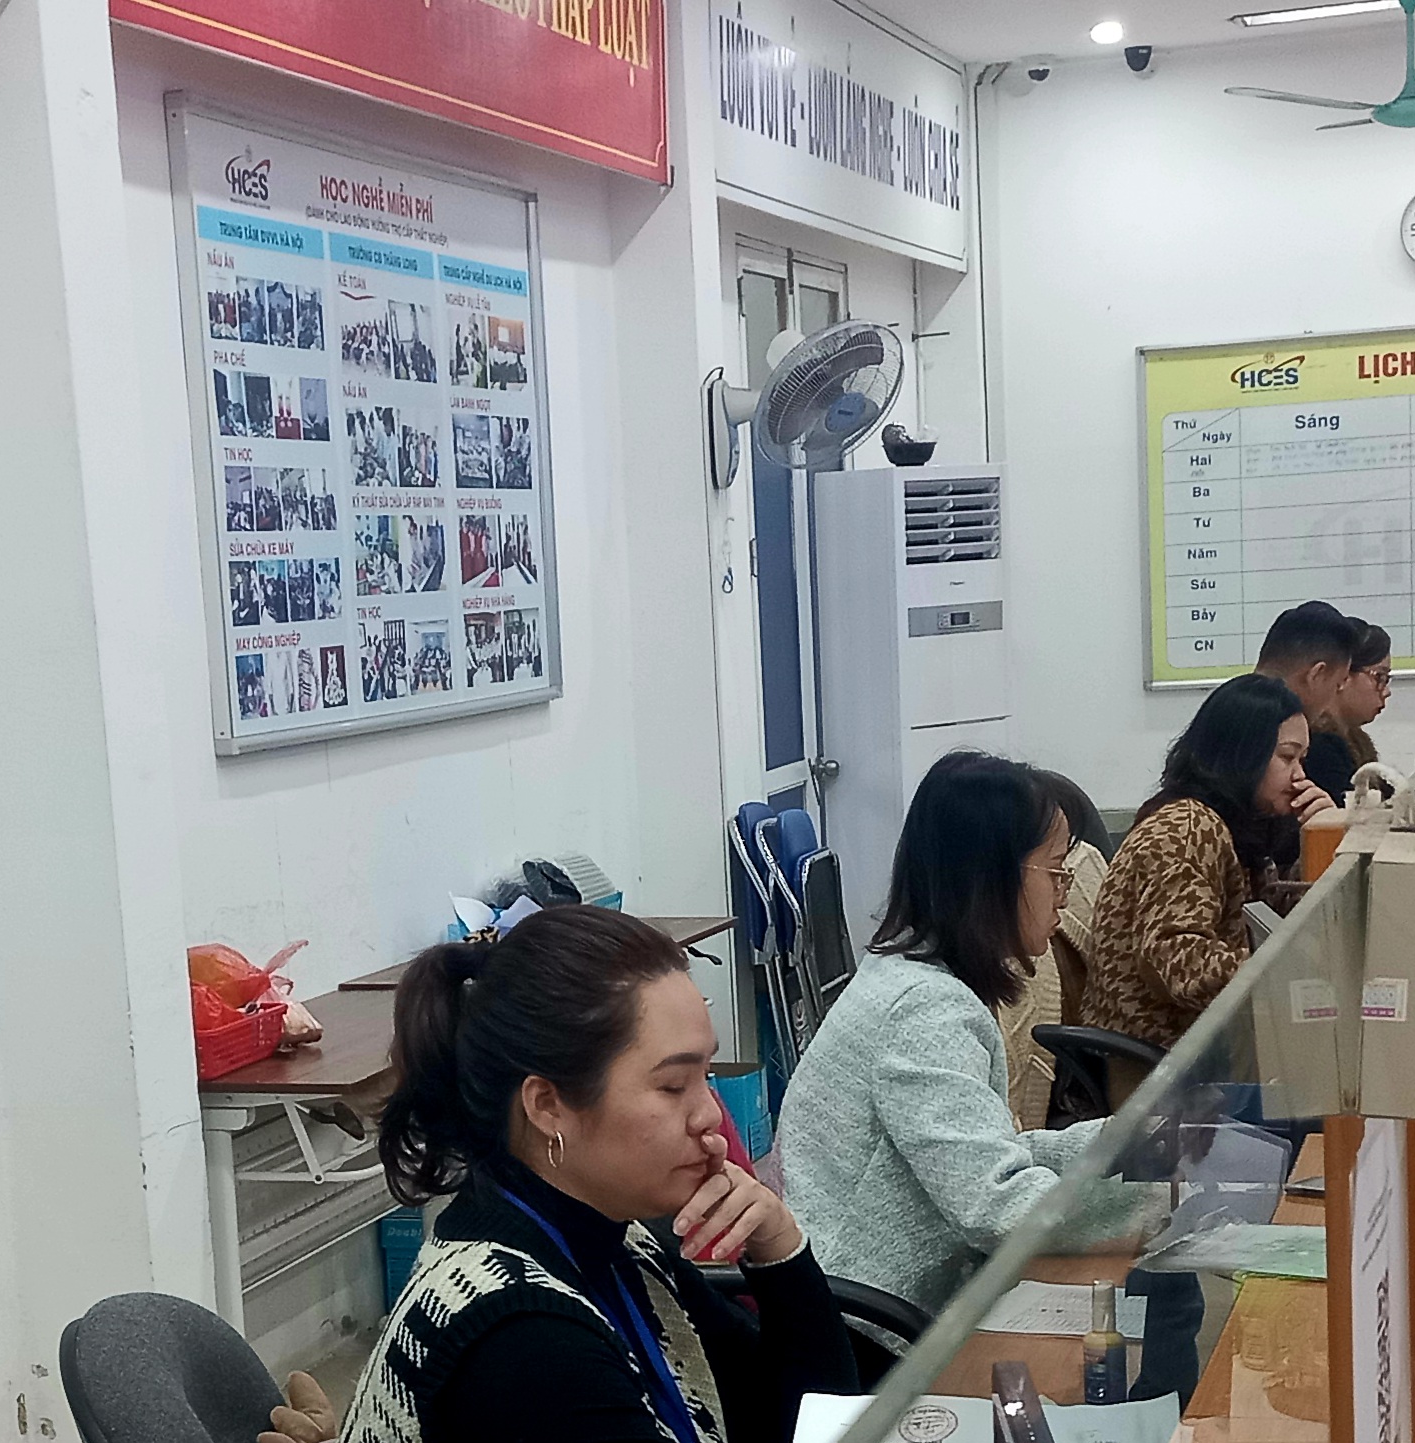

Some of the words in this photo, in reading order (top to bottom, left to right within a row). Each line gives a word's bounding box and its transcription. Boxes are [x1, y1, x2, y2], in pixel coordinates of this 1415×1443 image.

[320, 175, 348, 209] HỌC
[415, 195, 433, 223] PHÍ
[1240, 366, 1300, 390] HCES
[1173, 418, 1197, 430] Thứ
[1294, 413, 1341, 431] Sáng
[1202, 431, 1232, 444] Ngày
[1190, 454, 1212, 467] Hai
[1192, 486, 1210, 498] Ba
[1193, 517, 1212, 529] Tư
[1187, 548, 1217, 560] Năm
[1190, 578, 1216, 590] Sáu
[1191, 609, 1217, 622] Bảy
[1194, 640, 1214, 652] CN
